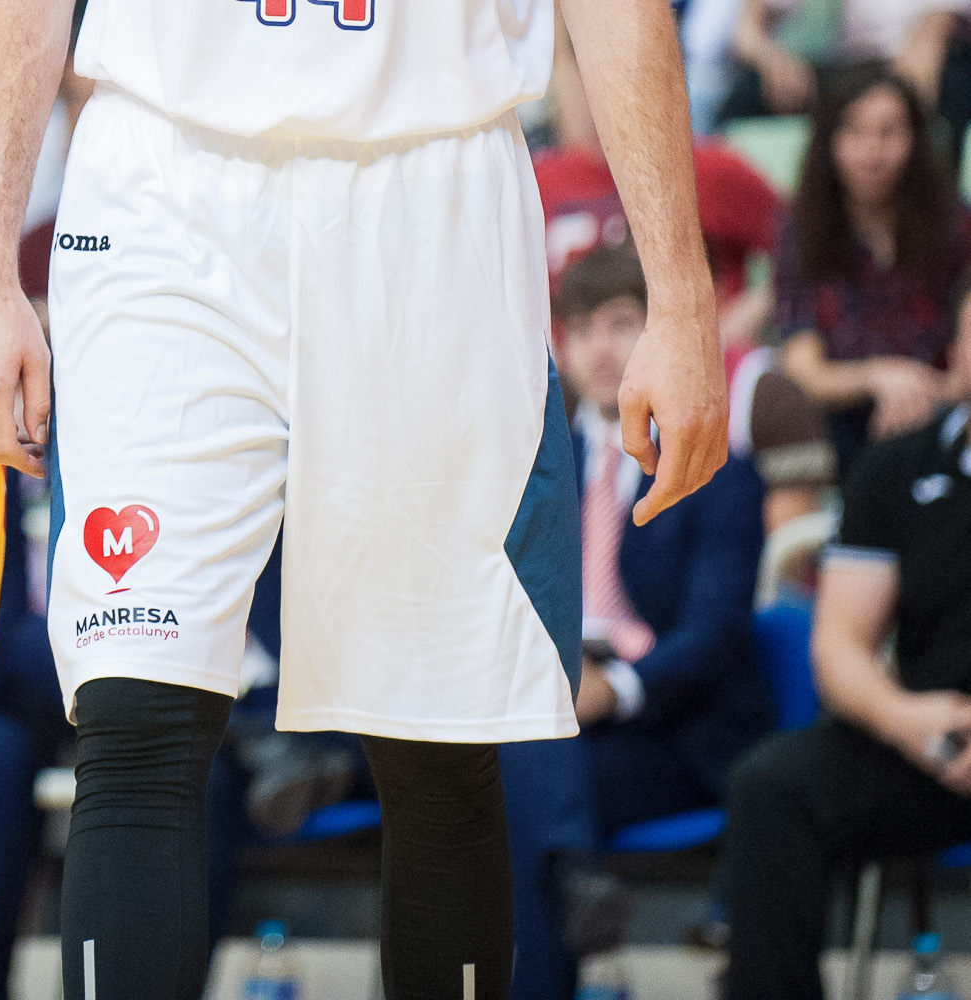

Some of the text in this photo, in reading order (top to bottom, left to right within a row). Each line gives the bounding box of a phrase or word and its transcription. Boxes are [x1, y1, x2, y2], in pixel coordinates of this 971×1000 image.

[54, 232, 112, 253] oma
[102, 526, 134, 558] M
[75, 606, 180, 638] MANRESA
[75, 624, 180, 649] Cor de Catalunya
